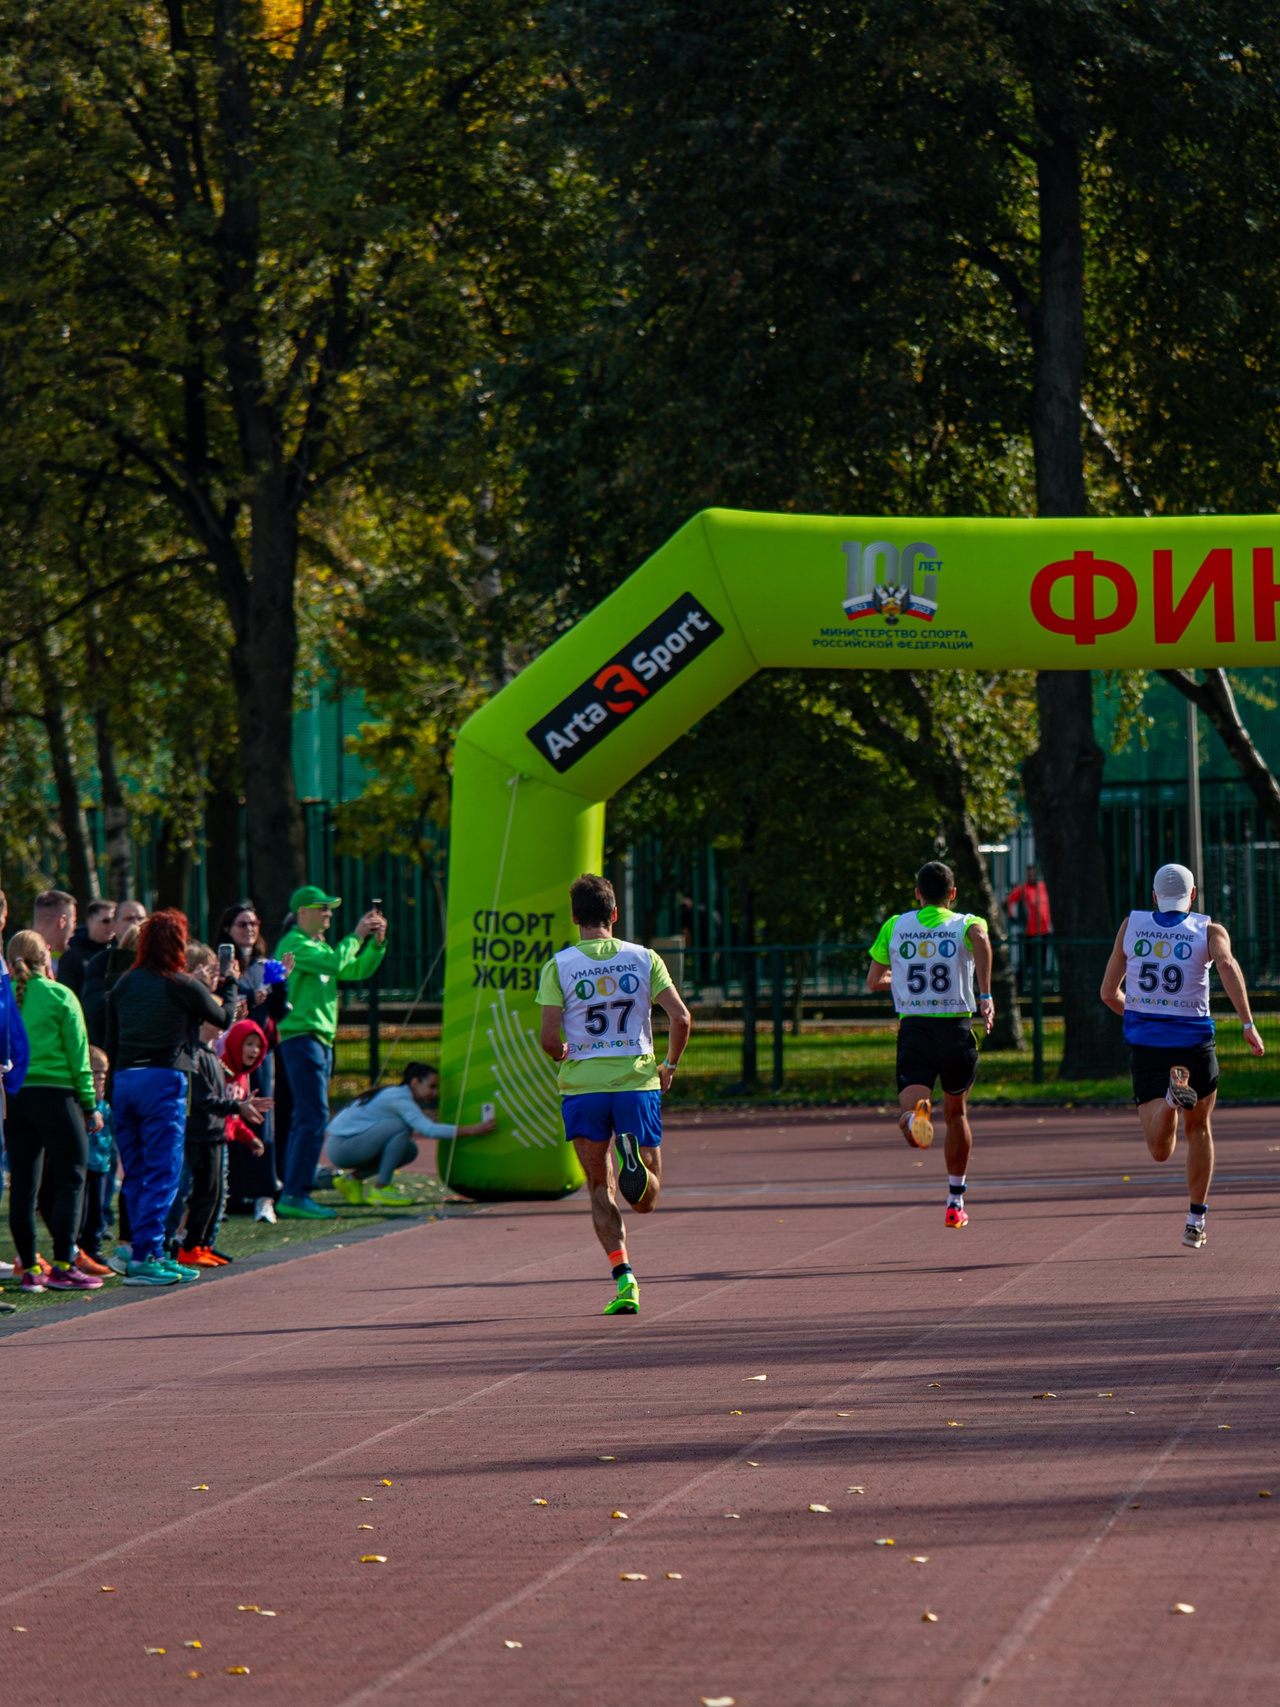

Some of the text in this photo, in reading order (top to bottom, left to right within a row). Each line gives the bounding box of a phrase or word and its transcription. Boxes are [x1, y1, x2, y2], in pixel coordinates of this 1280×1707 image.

[918, 561, 944, 571] ЛЕТ
[812, 638, 974, 651] РОССИЙСКОЙ ФЕДЕРАЦИИ
[820, 628, 968, 639] МИНИСТЕРСТВО СПОРТА
[544, 611, 711, 761] Arta Sport
[473, 909, 555, 936] СПОРТ
[900, 931, 957, 941] VMARAFONE
[1135, 930, 1194, 942] VMARAFONE
[473, 936, 572, 963] НОРМ
[472, 964, 541, 991] ЖИЗ
[570, 964, 638, 981] VMARAFONE
[907, 962, 952, 996] 58
[1137, 961, 1185, 996] 59
[584, 998, 636, 1038] 57
